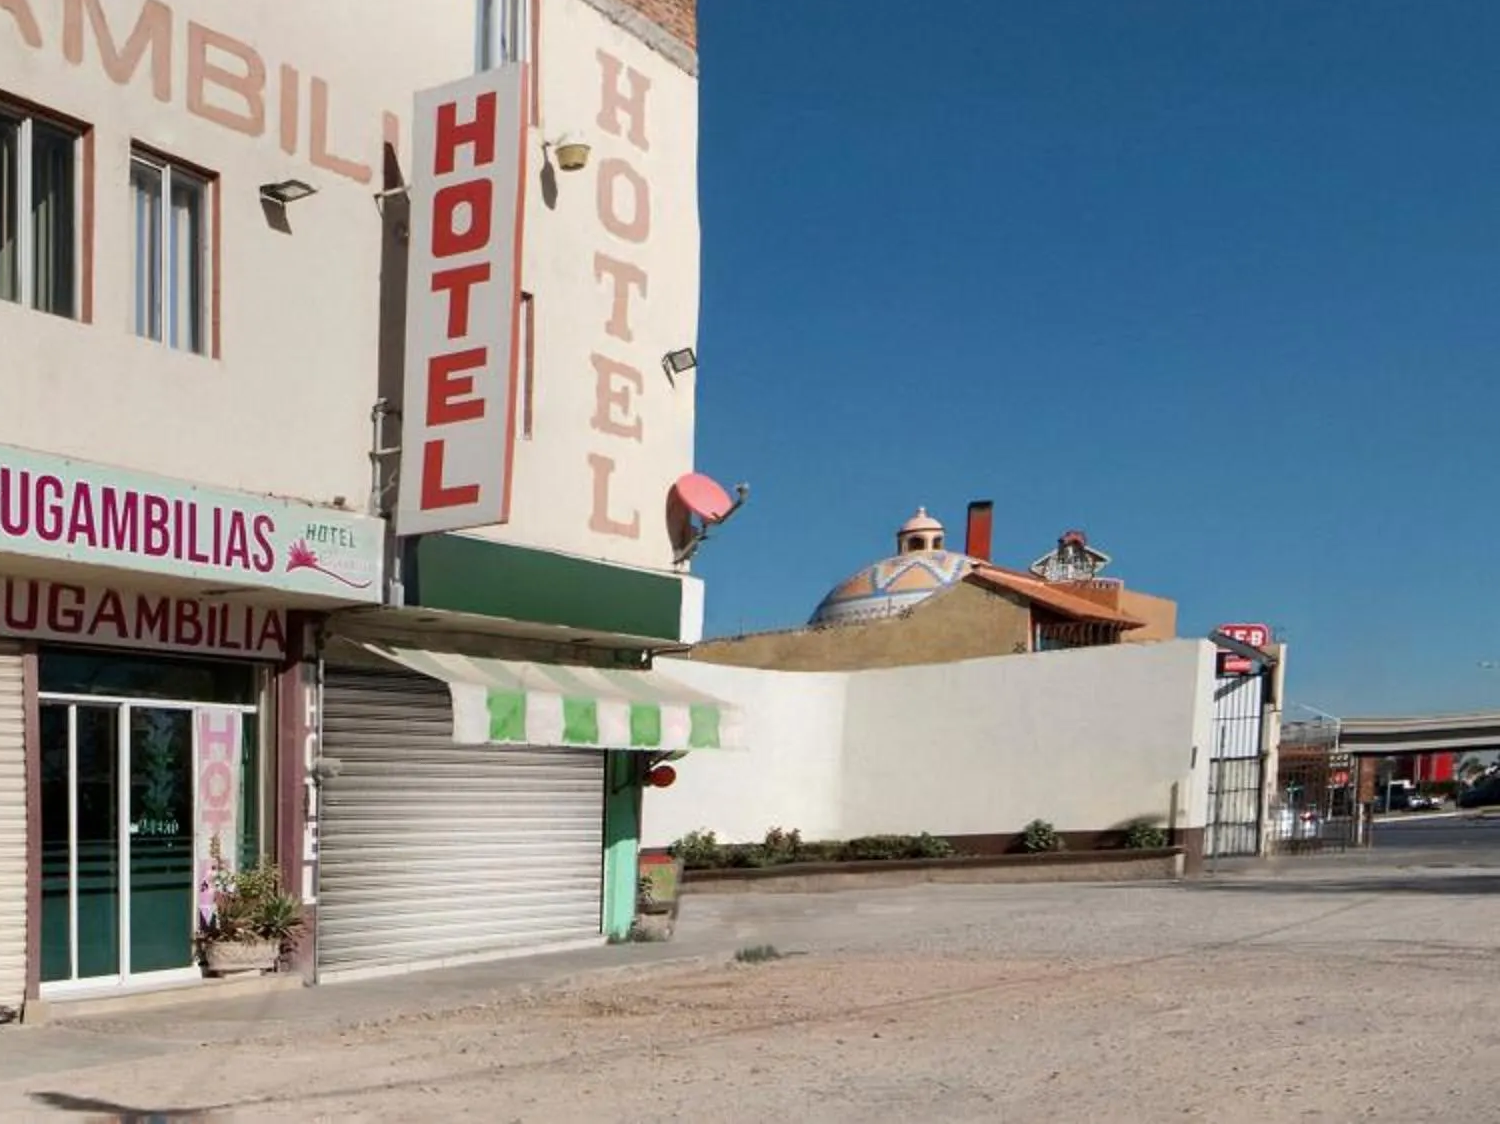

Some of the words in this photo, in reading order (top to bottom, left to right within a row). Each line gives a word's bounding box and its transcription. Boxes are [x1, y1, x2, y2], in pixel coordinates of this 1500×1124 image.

[420, 91, 497, 511] HOTEL
[587, 47, 651, 540] HOTEL
[306, 524, 356, 549] HOTEL
